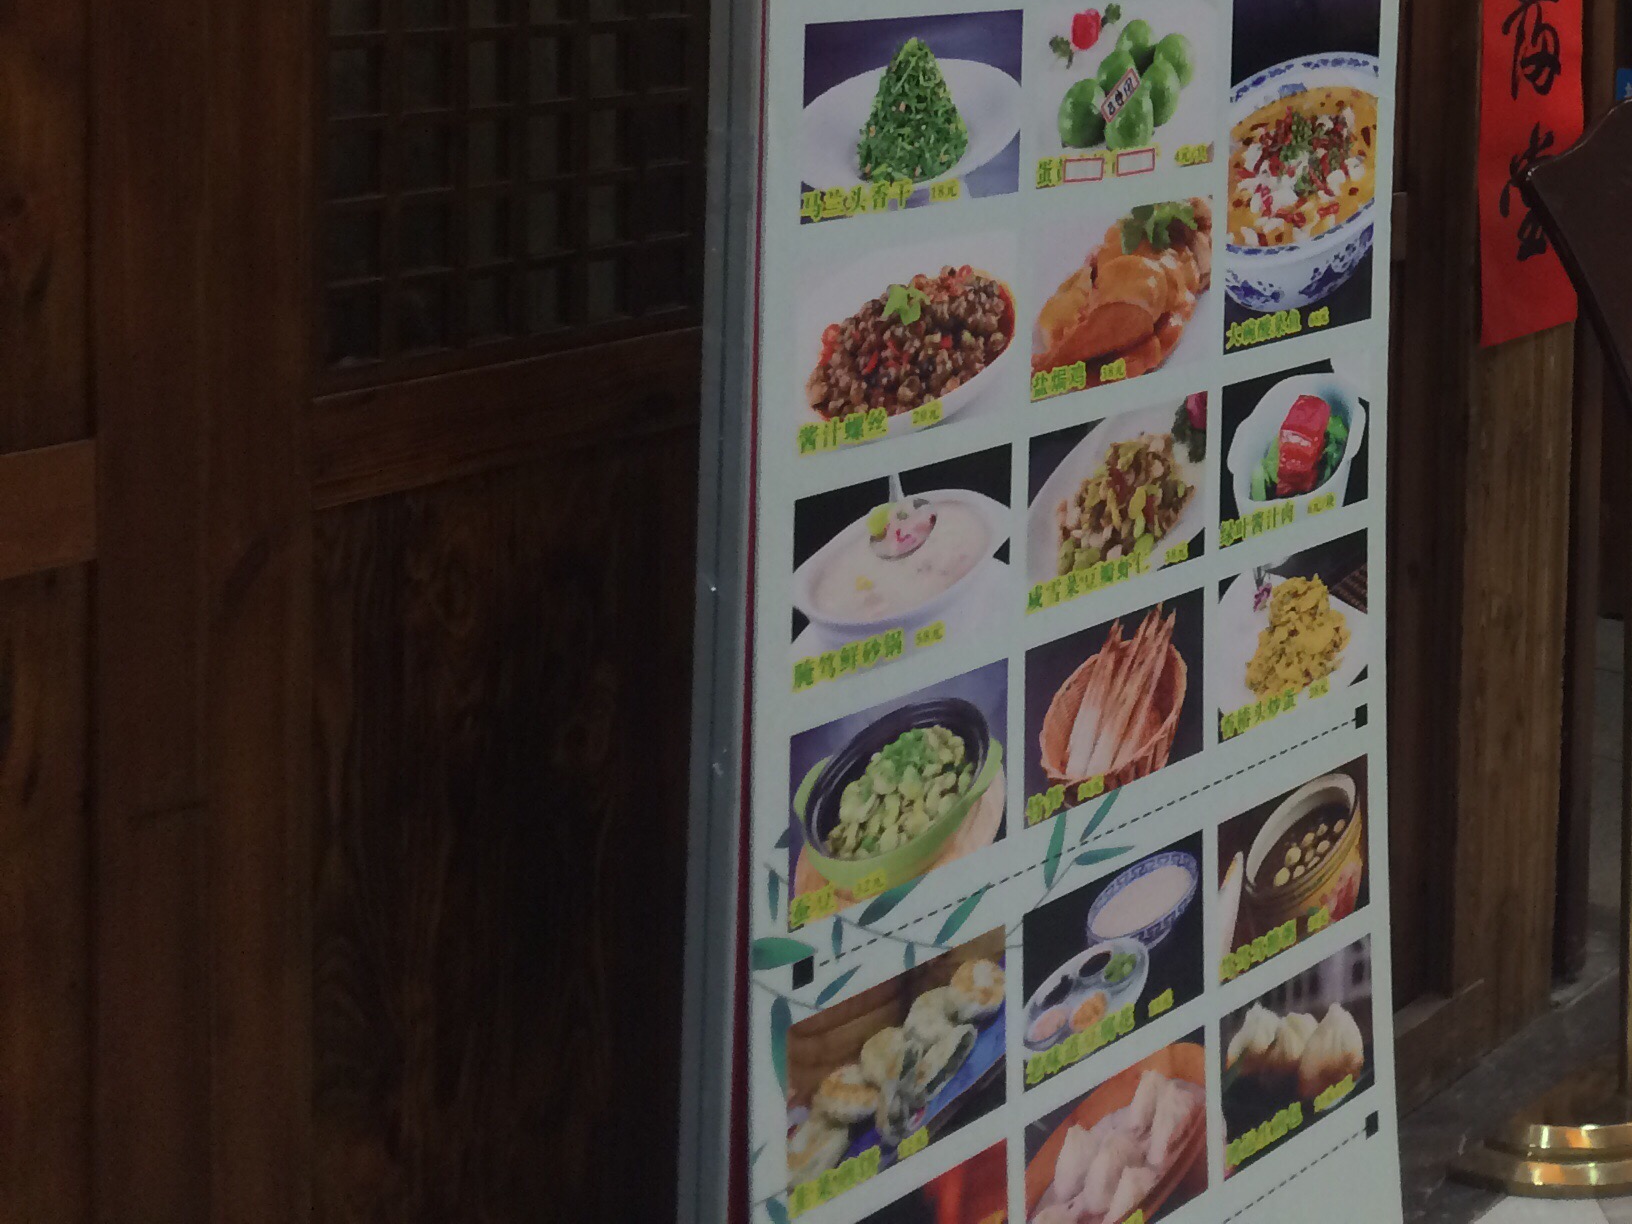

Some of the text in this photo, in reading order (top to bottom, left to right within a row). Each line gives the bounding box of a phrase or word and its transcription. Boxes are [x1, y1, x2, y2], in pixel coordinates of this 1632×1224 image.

[802, 180, 911, 222] 马兰头香干
